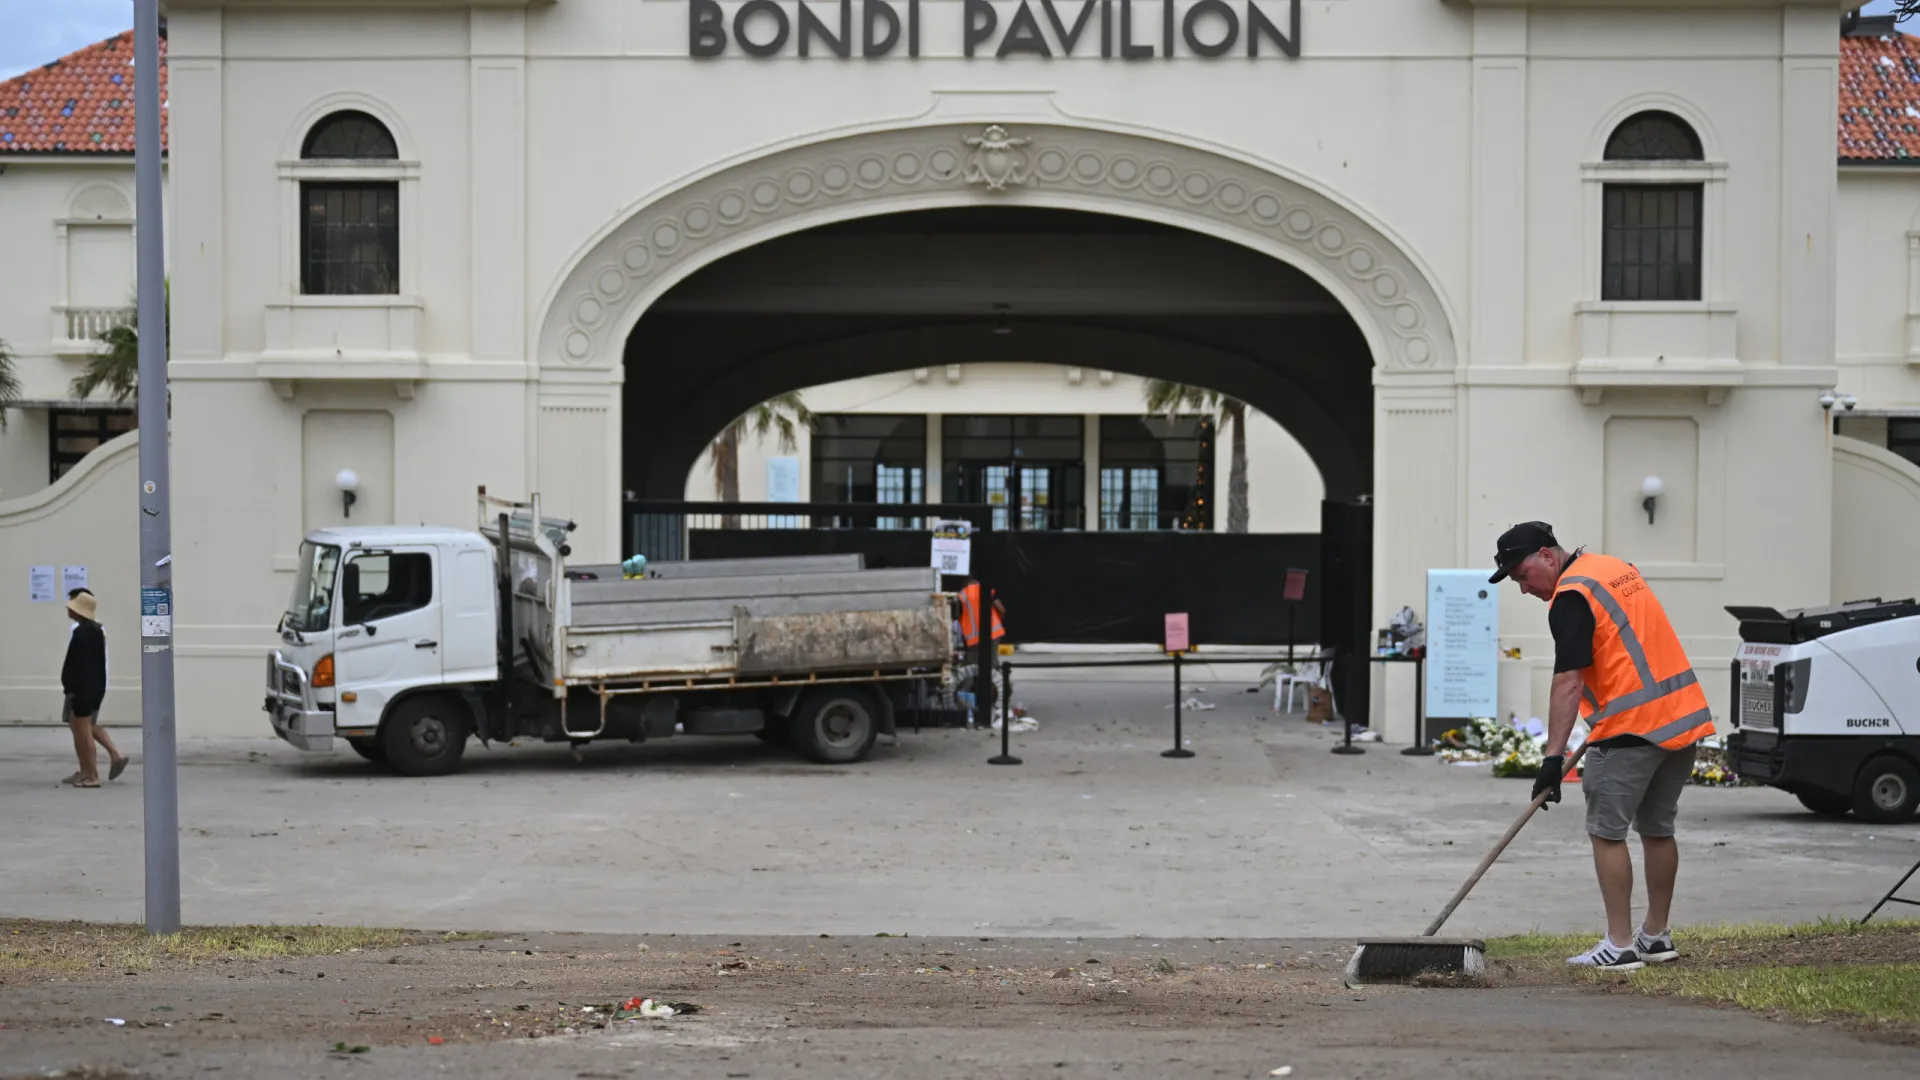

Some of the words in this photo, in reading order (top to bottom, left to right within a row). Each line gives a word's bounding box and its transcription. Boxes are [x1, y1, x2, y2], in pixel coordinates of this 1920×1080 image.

[690, 0, 918, 58] BONDI
[965, 0, 1301, 58] PAVILION
[1747, 700, 1773, 712] BUCHER
[1846, 718, 1890, 728] BUCHER
